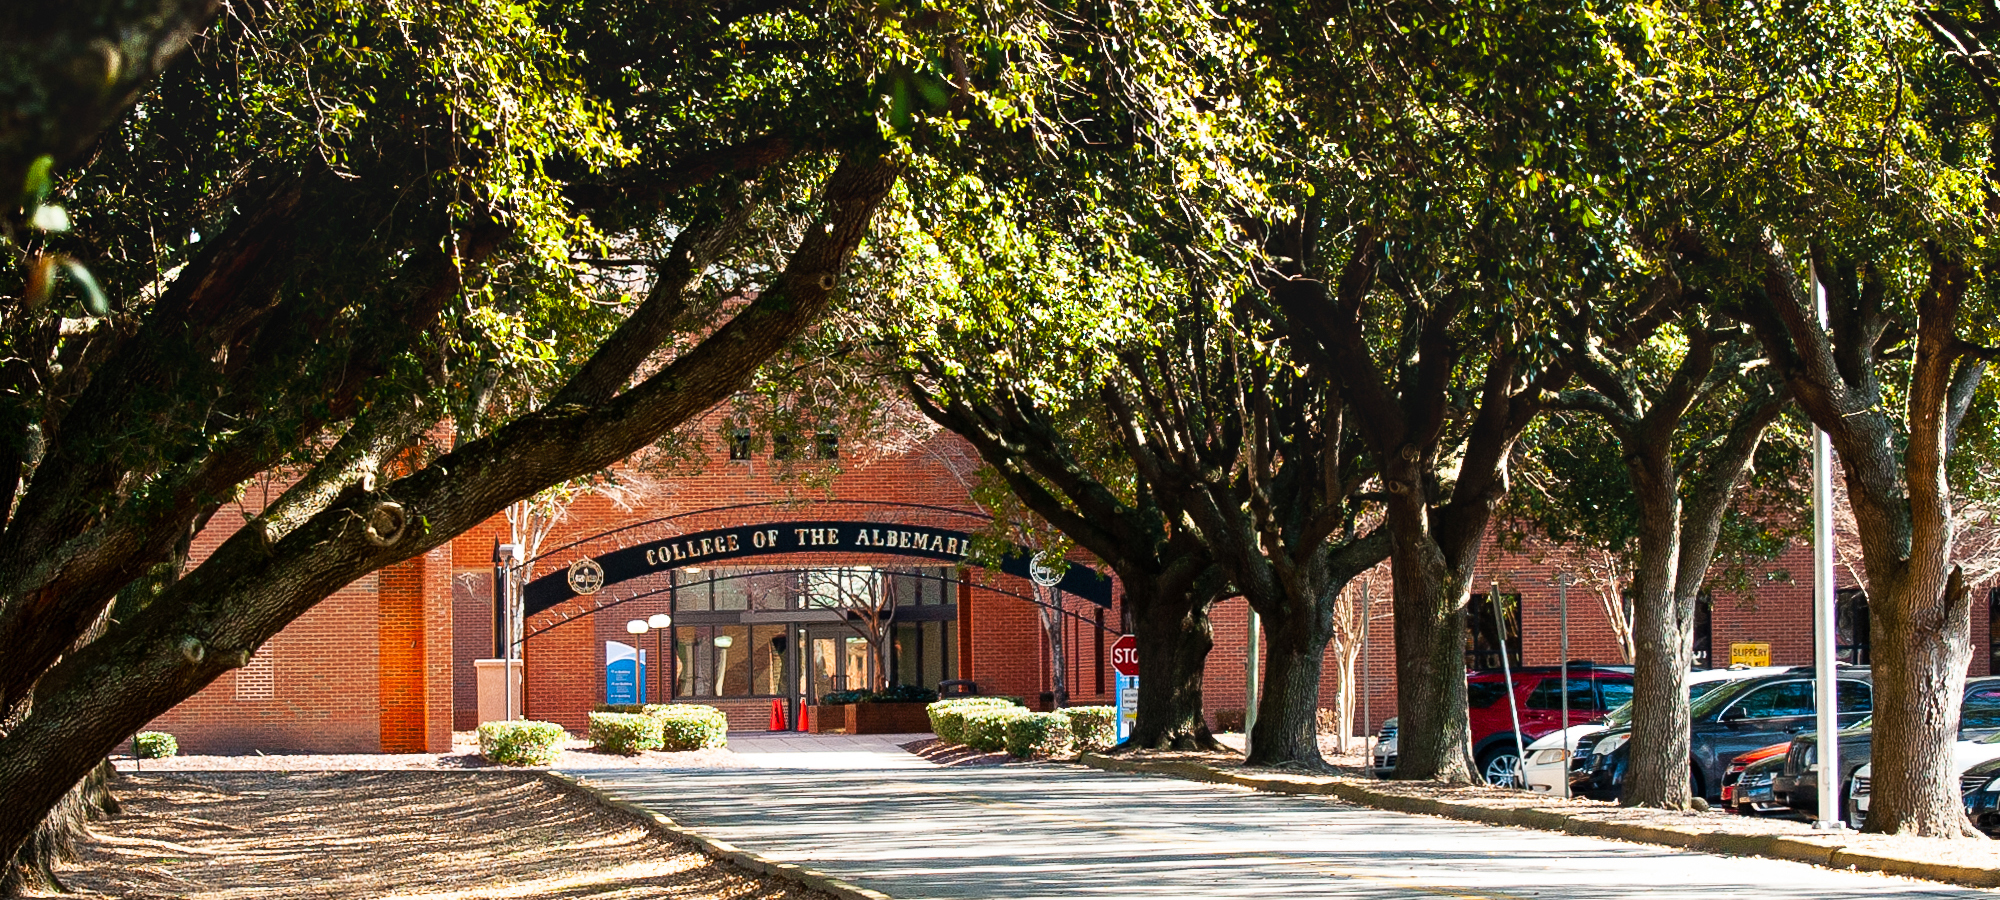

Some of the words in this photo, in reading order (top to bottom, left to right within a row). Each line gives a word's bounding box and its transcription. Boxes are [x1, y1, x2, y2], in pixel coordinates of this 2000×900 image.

[646, 533, 740, 566] COLLEGE
[753, 529, 779, 548] OF
[794, 528, 839, 545] THE
[855, 529, 980, 558] ALBEMARL
[1114, 647, 1139, 664] STO
[1733, 648, 1767, 657] SLIPPERY
